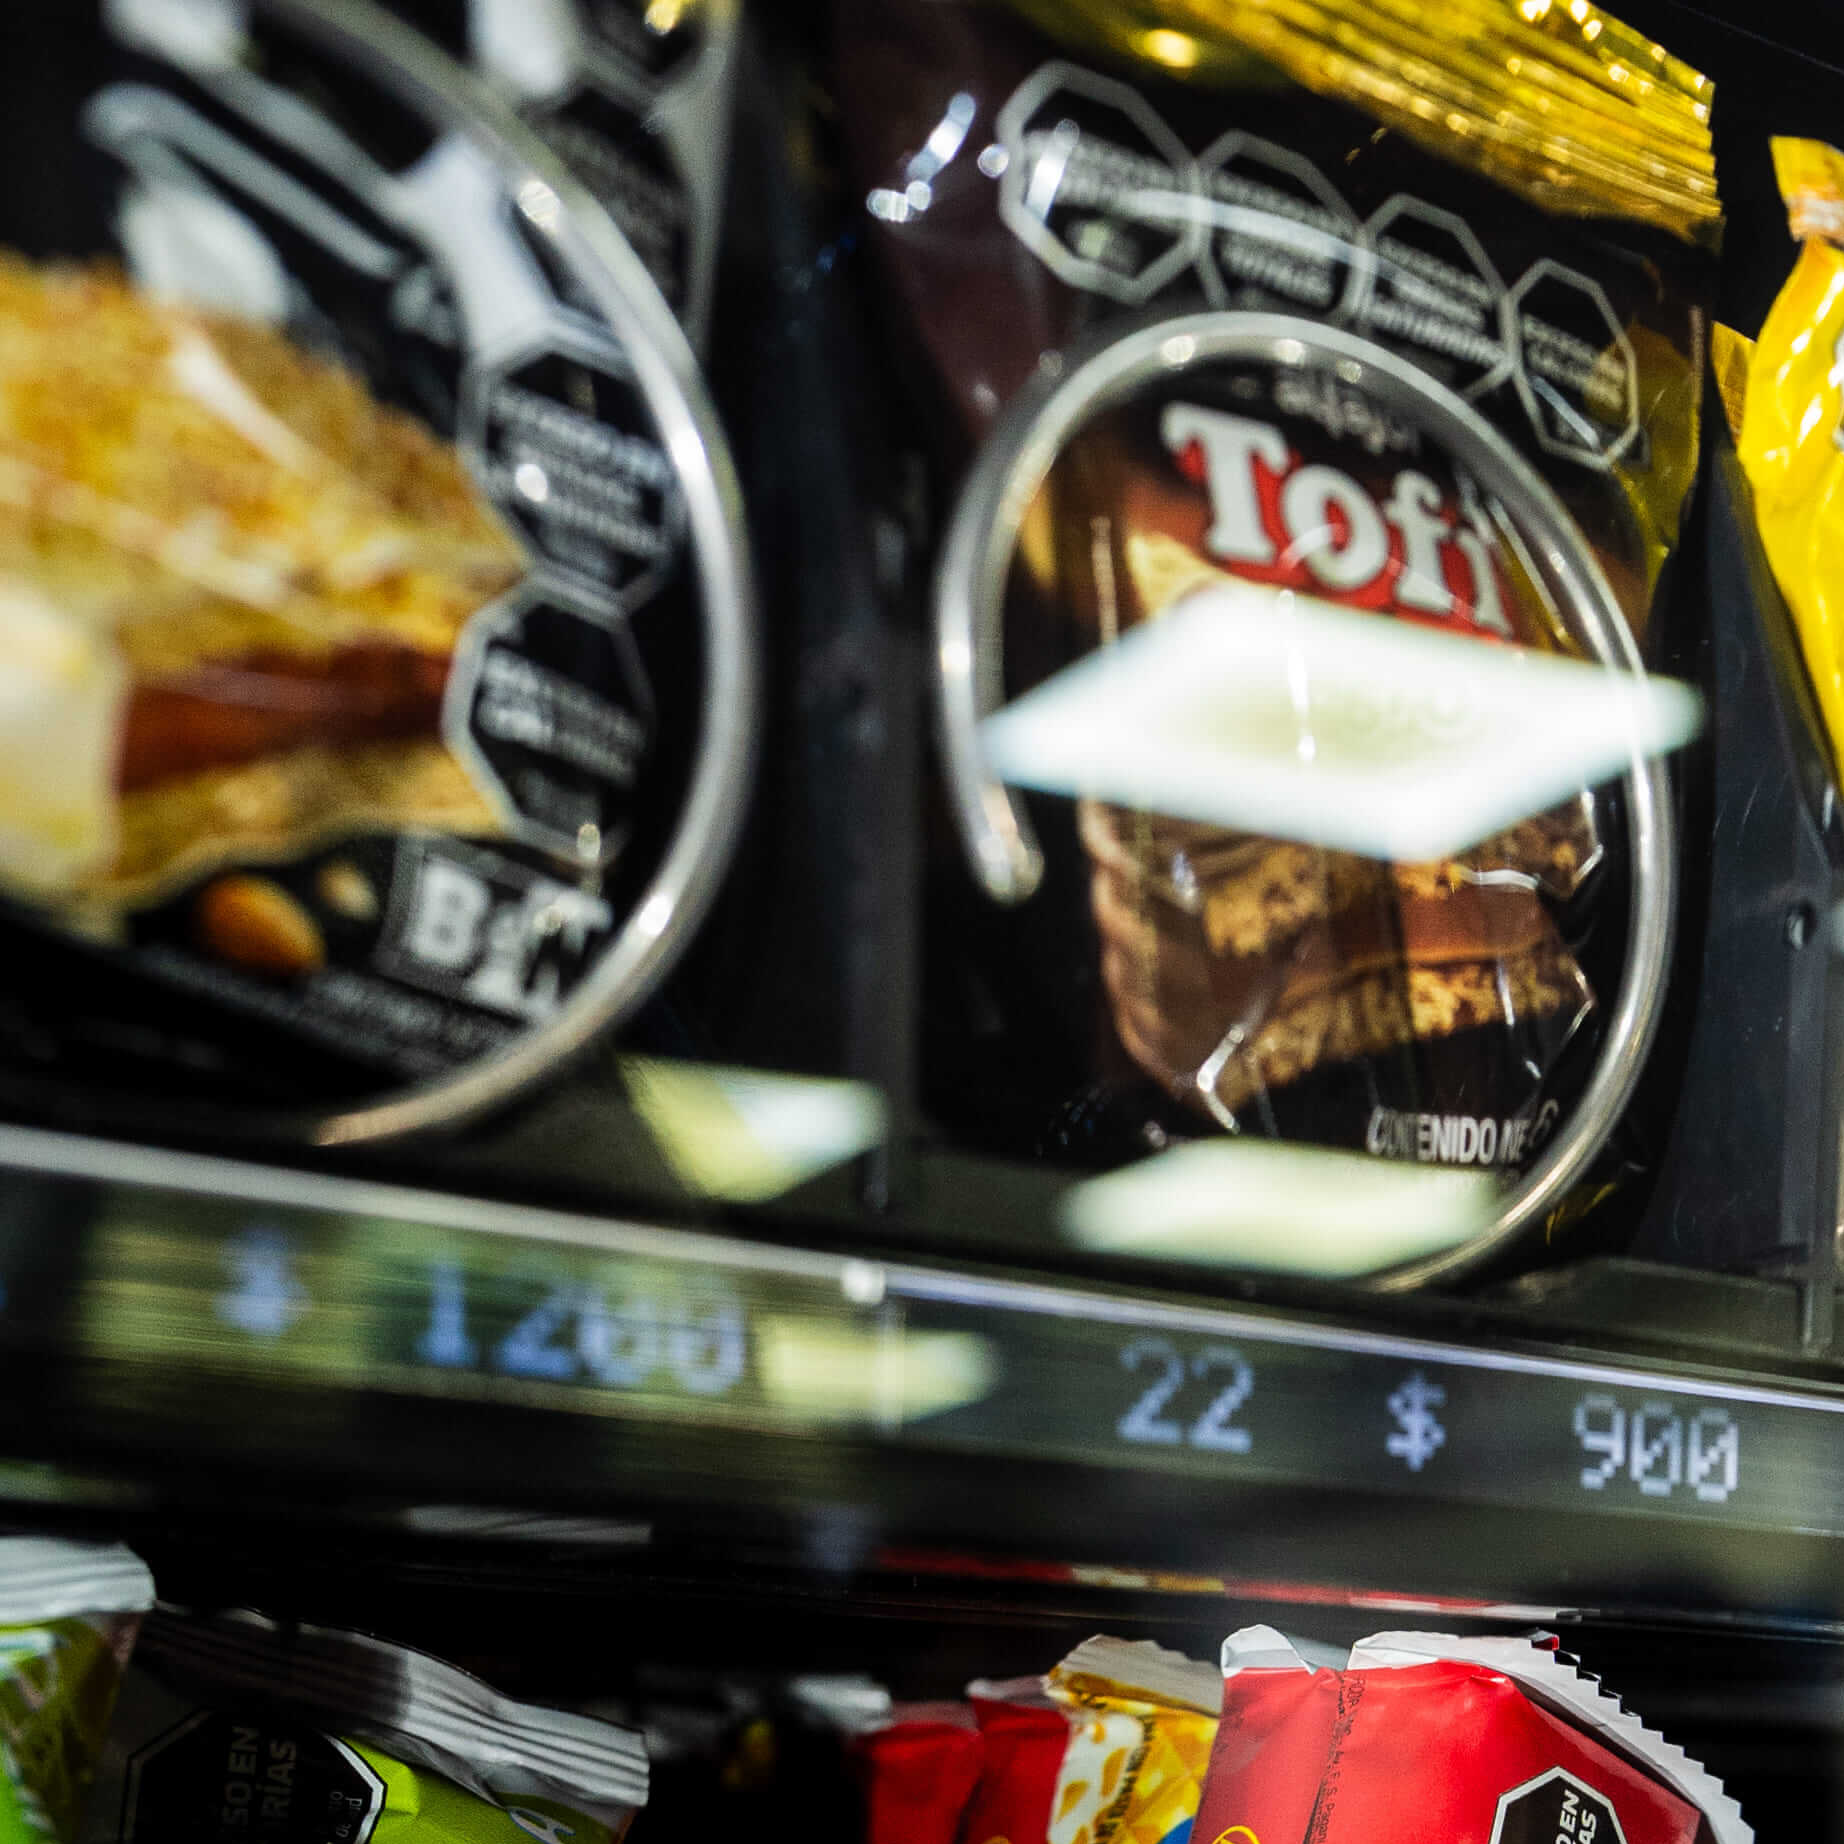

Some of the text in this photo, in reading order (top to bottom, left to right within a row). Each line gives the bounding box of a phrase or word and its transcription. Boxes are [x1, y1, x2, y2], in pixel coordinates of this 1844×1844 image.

[1116, 1336, 1740, 1501] 22 $ 900
[1559, 1788, 1582, 1834] EN
